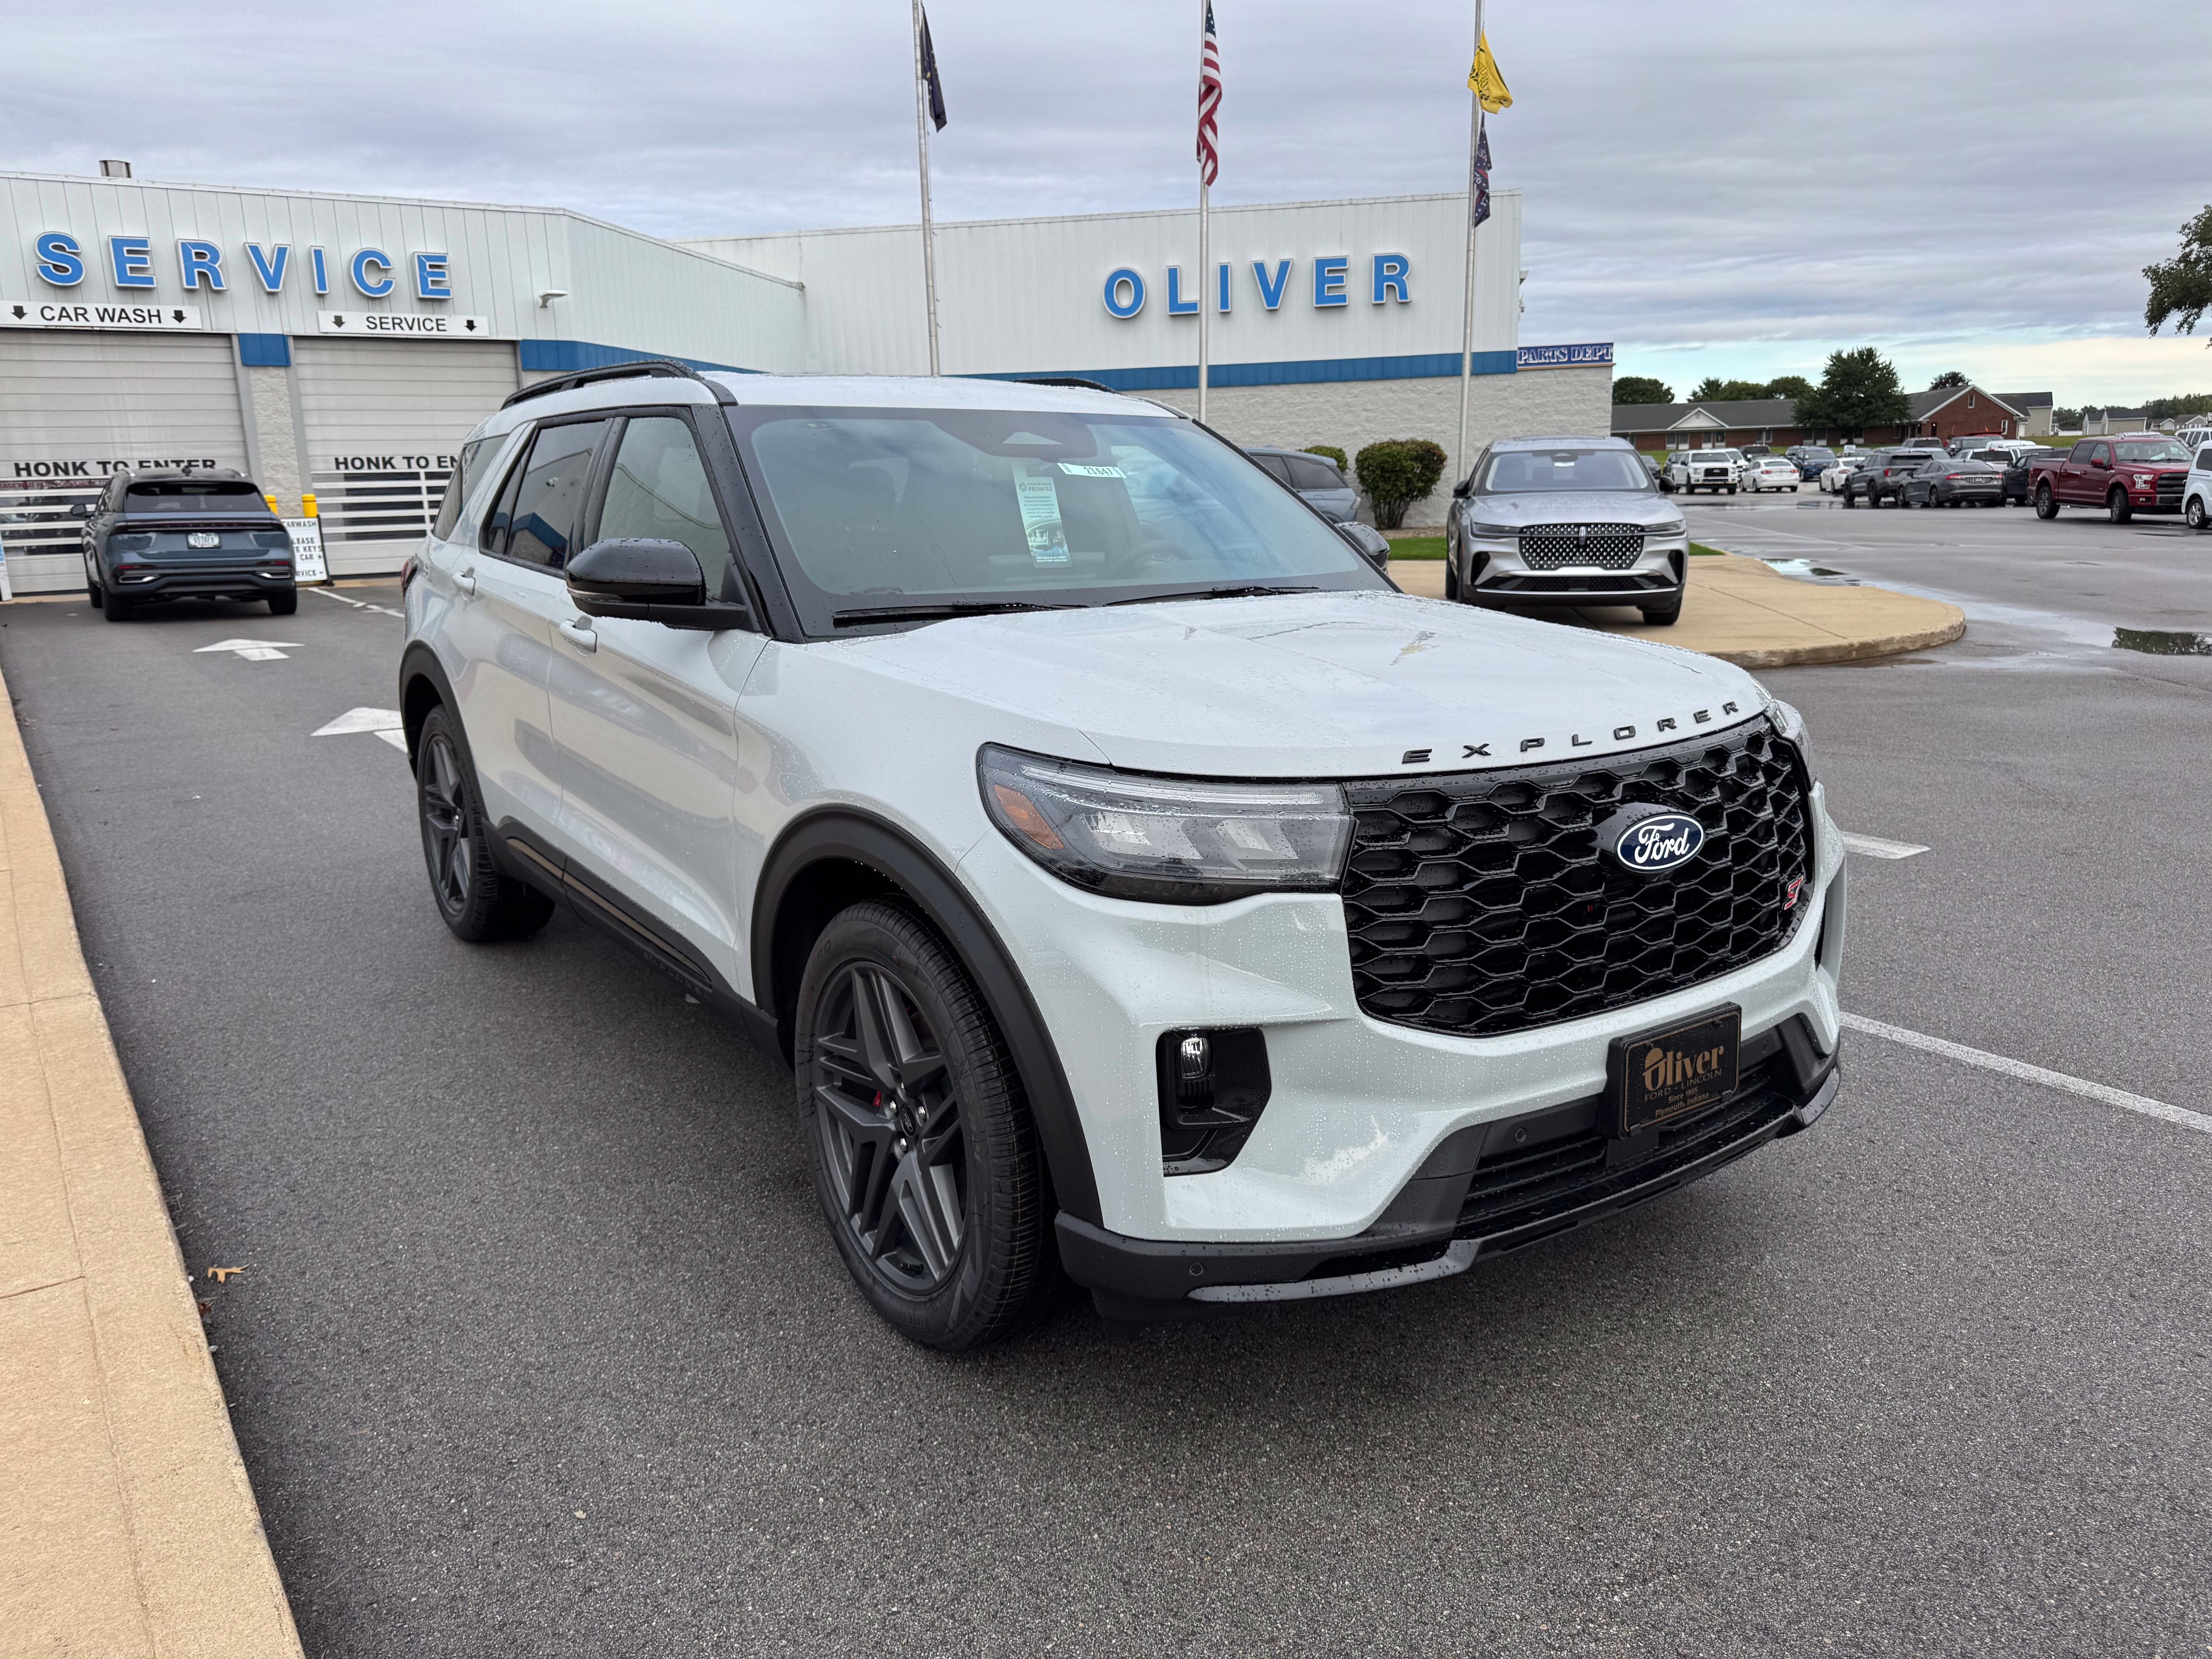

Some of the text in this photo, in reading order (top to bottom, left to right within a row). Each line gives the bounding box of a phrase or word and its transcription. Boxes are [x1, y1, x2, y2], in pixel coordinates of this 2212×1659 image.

[35, 231, 453, 299] SERVICE
[1102, 252, 1412, 319] OLIVER
[40, 306, 162, 324] CAR WASH
[366, 316, 447, 331] SERVICE
[1518, 346, 1613, 364] PARTS DEPT
[14, 461, 90, 477] HONK
[96, 461, 129, 475] TO
[334, 456, 397, 470] HONK
[402, 456, 429, 469] TO
[1402, 701, 1739, 764] EXPLORER
[1634, 823, 1690, 864] Ford
[1642, 1046, 1724, 1091] Oliver
[1645, 1069, 1721, 1102] FORD LINCOLN
[1668, 1087, 1698, 1104] Since 1955
[1687, 1092, 1709, 1106] Indiana
